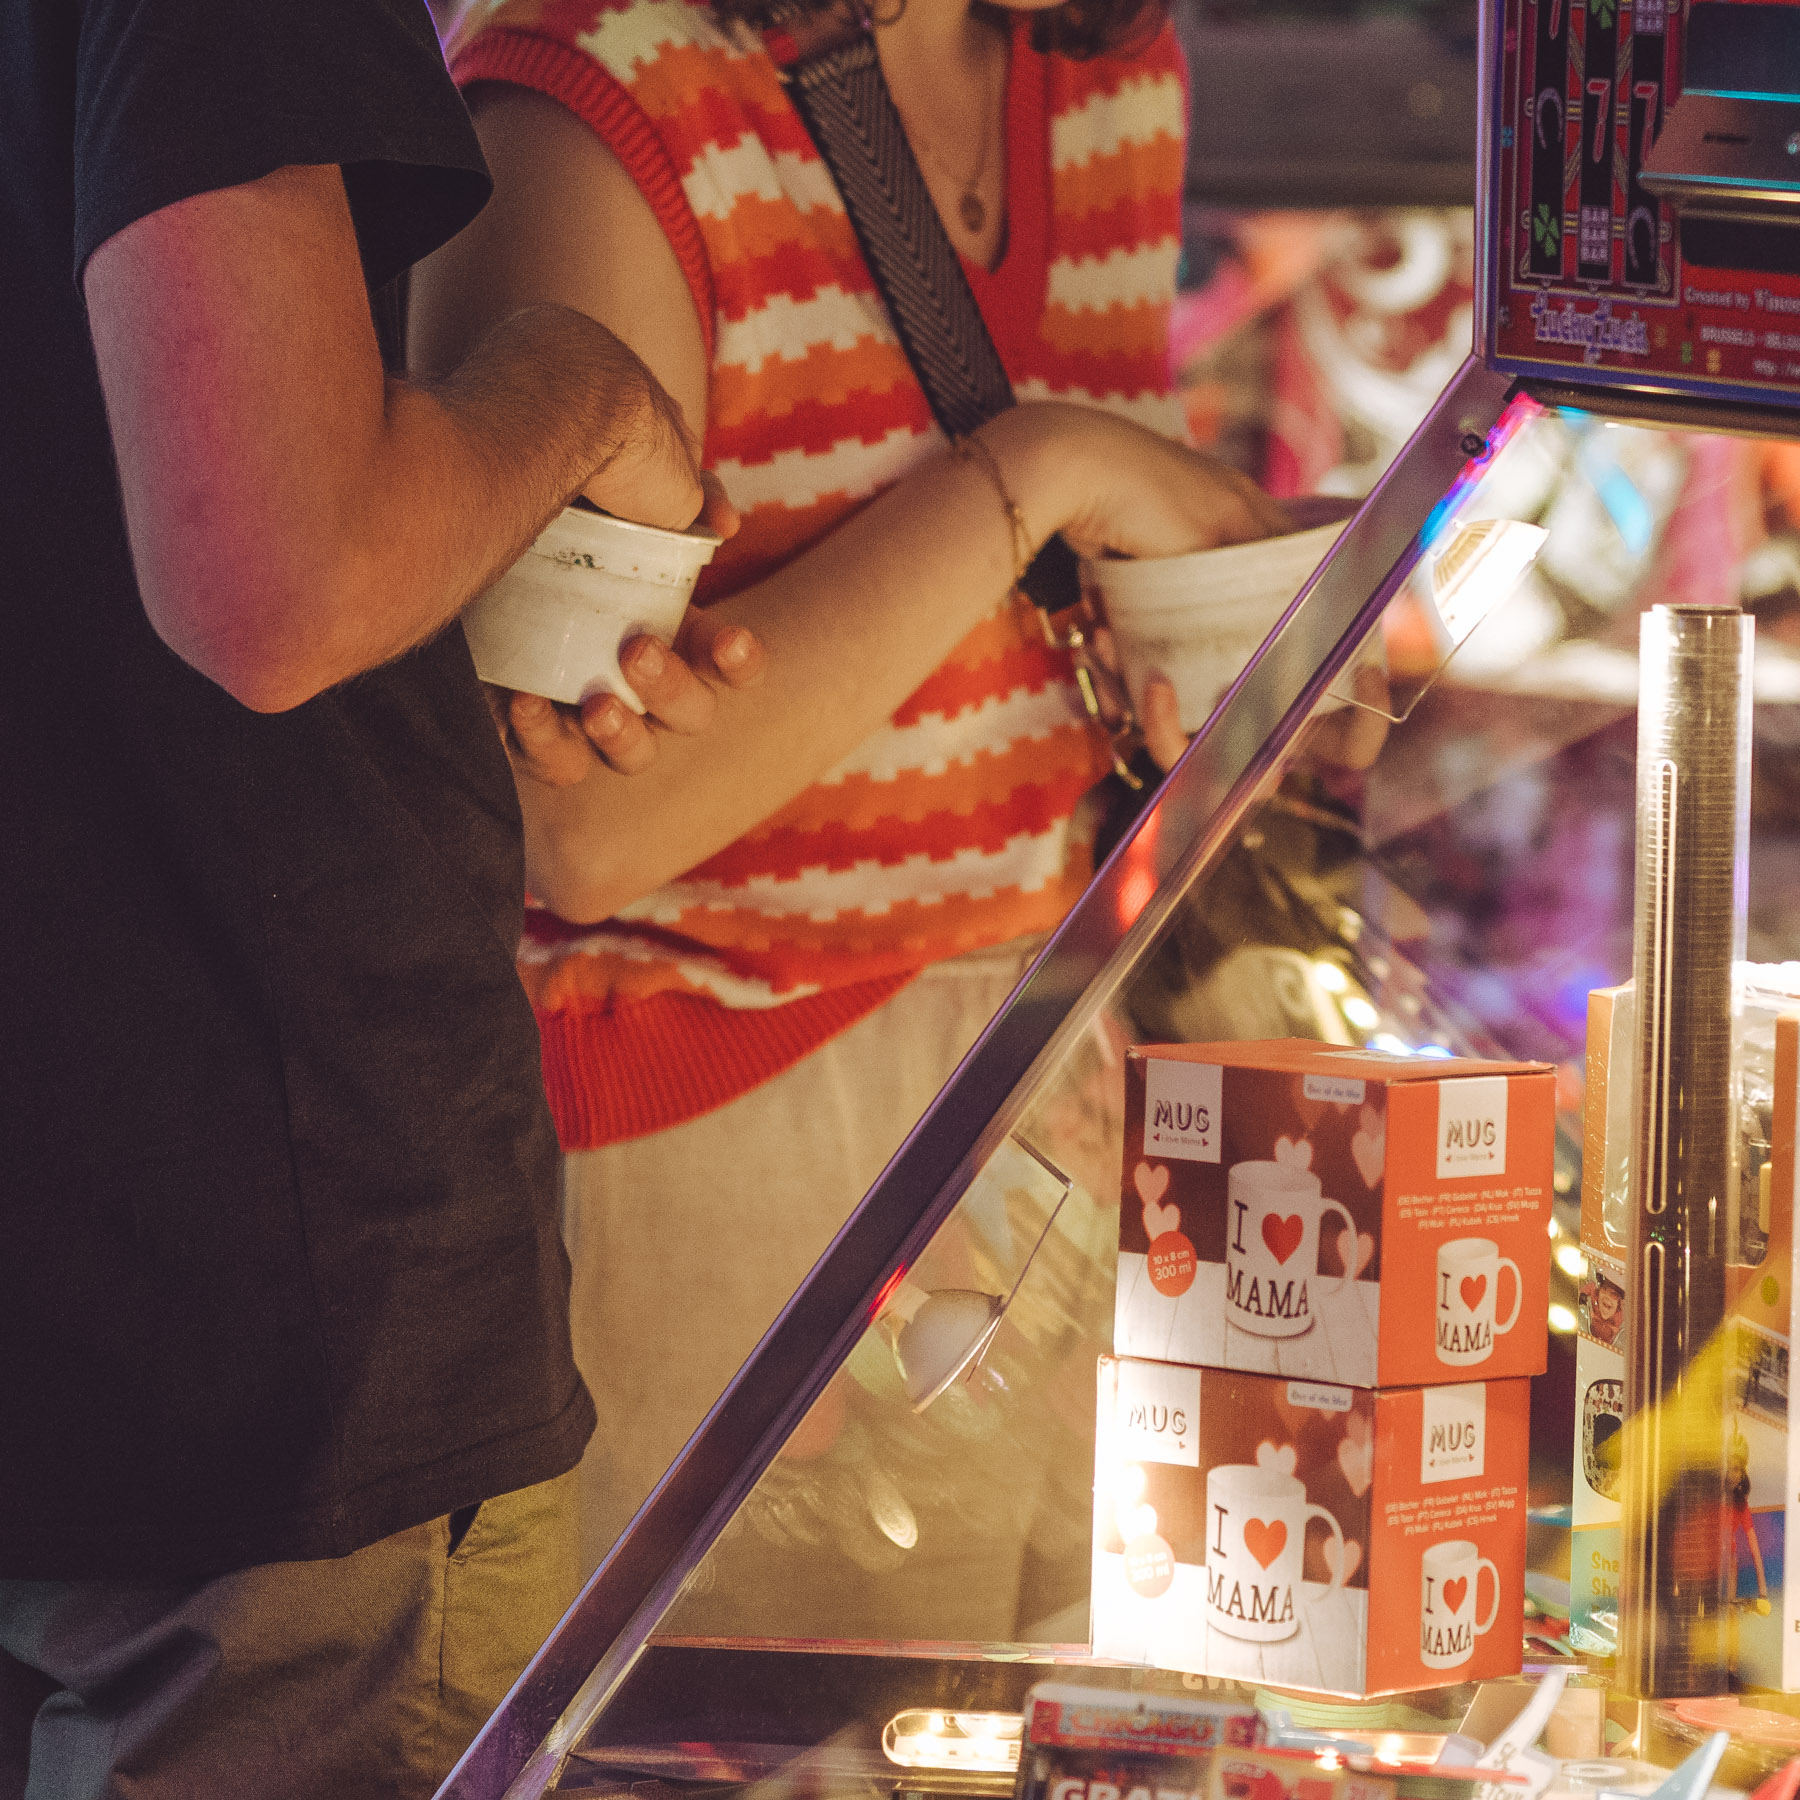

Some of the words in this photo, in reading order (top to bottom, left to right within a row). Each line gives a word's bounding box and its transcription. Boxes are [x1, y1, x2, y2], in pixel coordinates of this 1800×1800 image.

[1586, 77, 1611, 164] 7
[1633, 80, 1660, 172] 7
[1153, 1099, 1211, 1135] MUG
[1445, 1117, 1497, 1149] MUG
[1231, 1198, 1249, 1255] I
[1152, 1254, 1164, 1266] 10
[1169, 1252, 1176, 1262] 8
[1154, 1264, 1177, 1281] 300
[1178, 1261, 1192, 1276] ml
[1226, 1260, 1310, 1319] MAMA
[1440, 1272, 1451, 1311] I
[1437, 1318, 1493, 1354] MAMA
[1128, 1402, 1187, 1436] MUG
[1429, 1420, 1477, 1453] MUG
[1212, 1503, 1229, 1559] I
[1206, 1565, 1295, 1625] MAMA
[1425, 1576, 1436, 1615] I
[1421, 1620, 1472, 1657] MAMA
